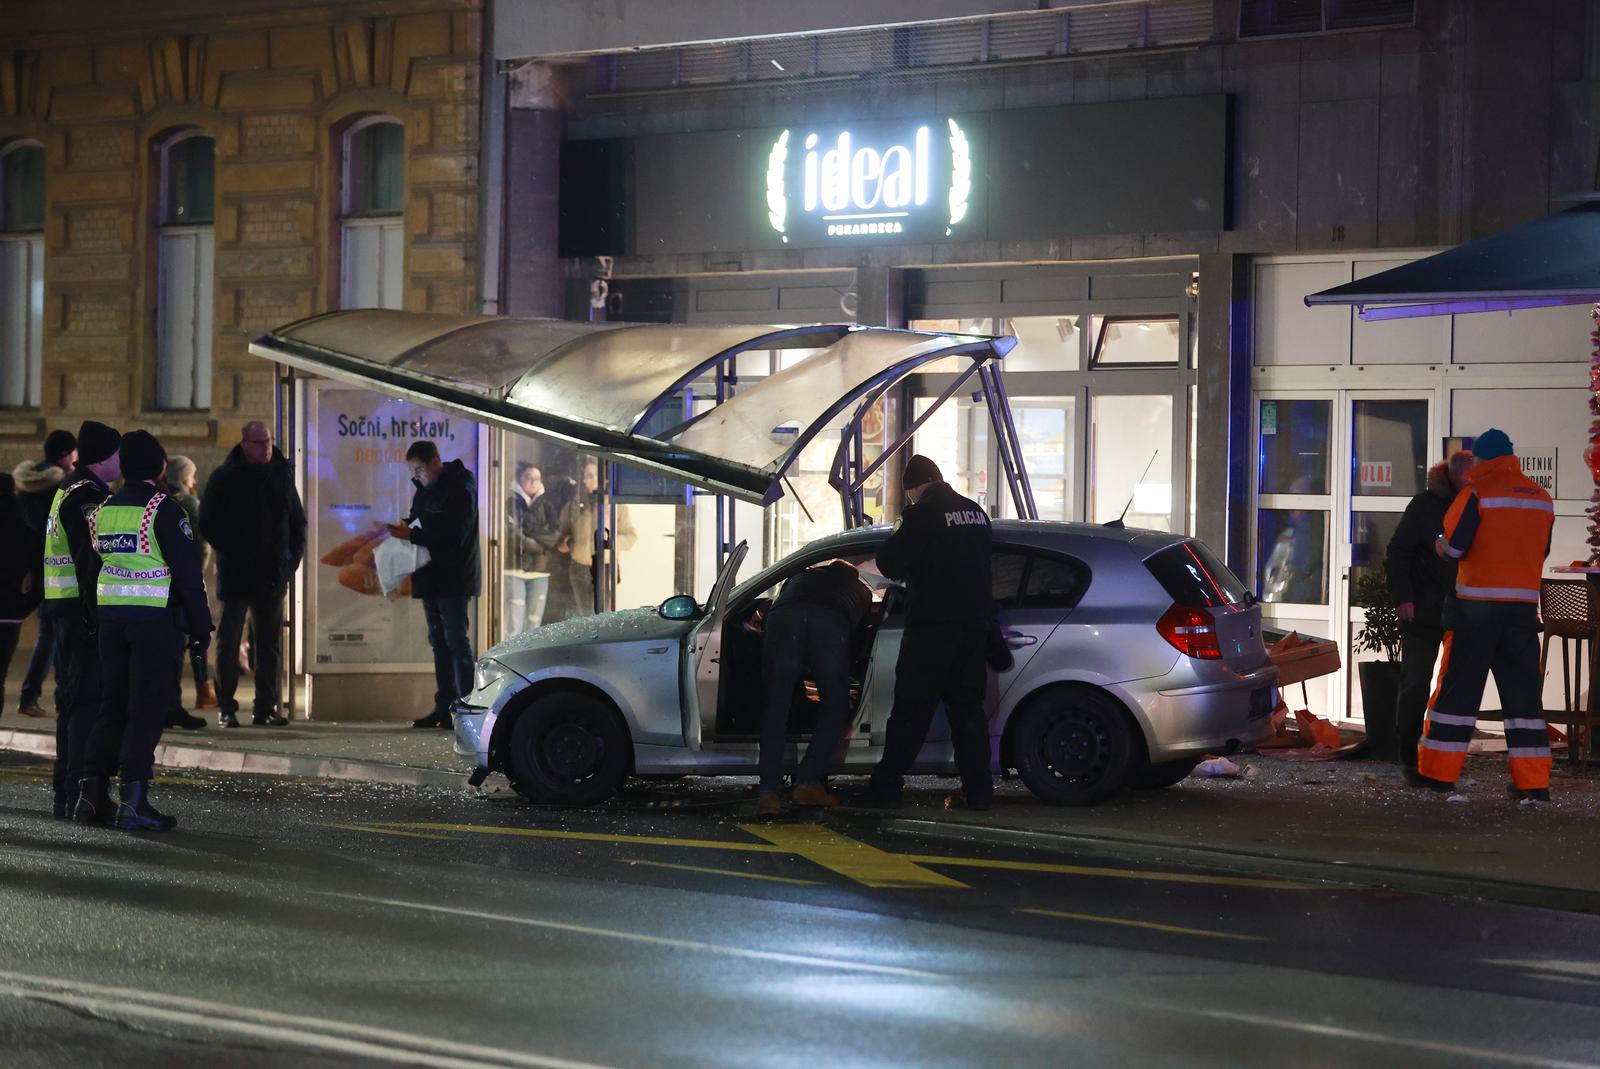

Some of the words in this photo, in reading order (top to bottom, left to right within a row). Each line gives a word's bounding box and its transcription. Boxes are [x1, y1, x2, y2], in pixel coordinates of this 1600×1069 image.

[804, 126, 929, 211] ideal
[338, 414, 387, 440] Sočni,
[391, 416, 455, 440] hrskavi,
[1360, 464, 1391, 482] ULAZ
[1519, 457, 1552, 472] JETNIK
[944, 511, 987, 527] POLICIJA
